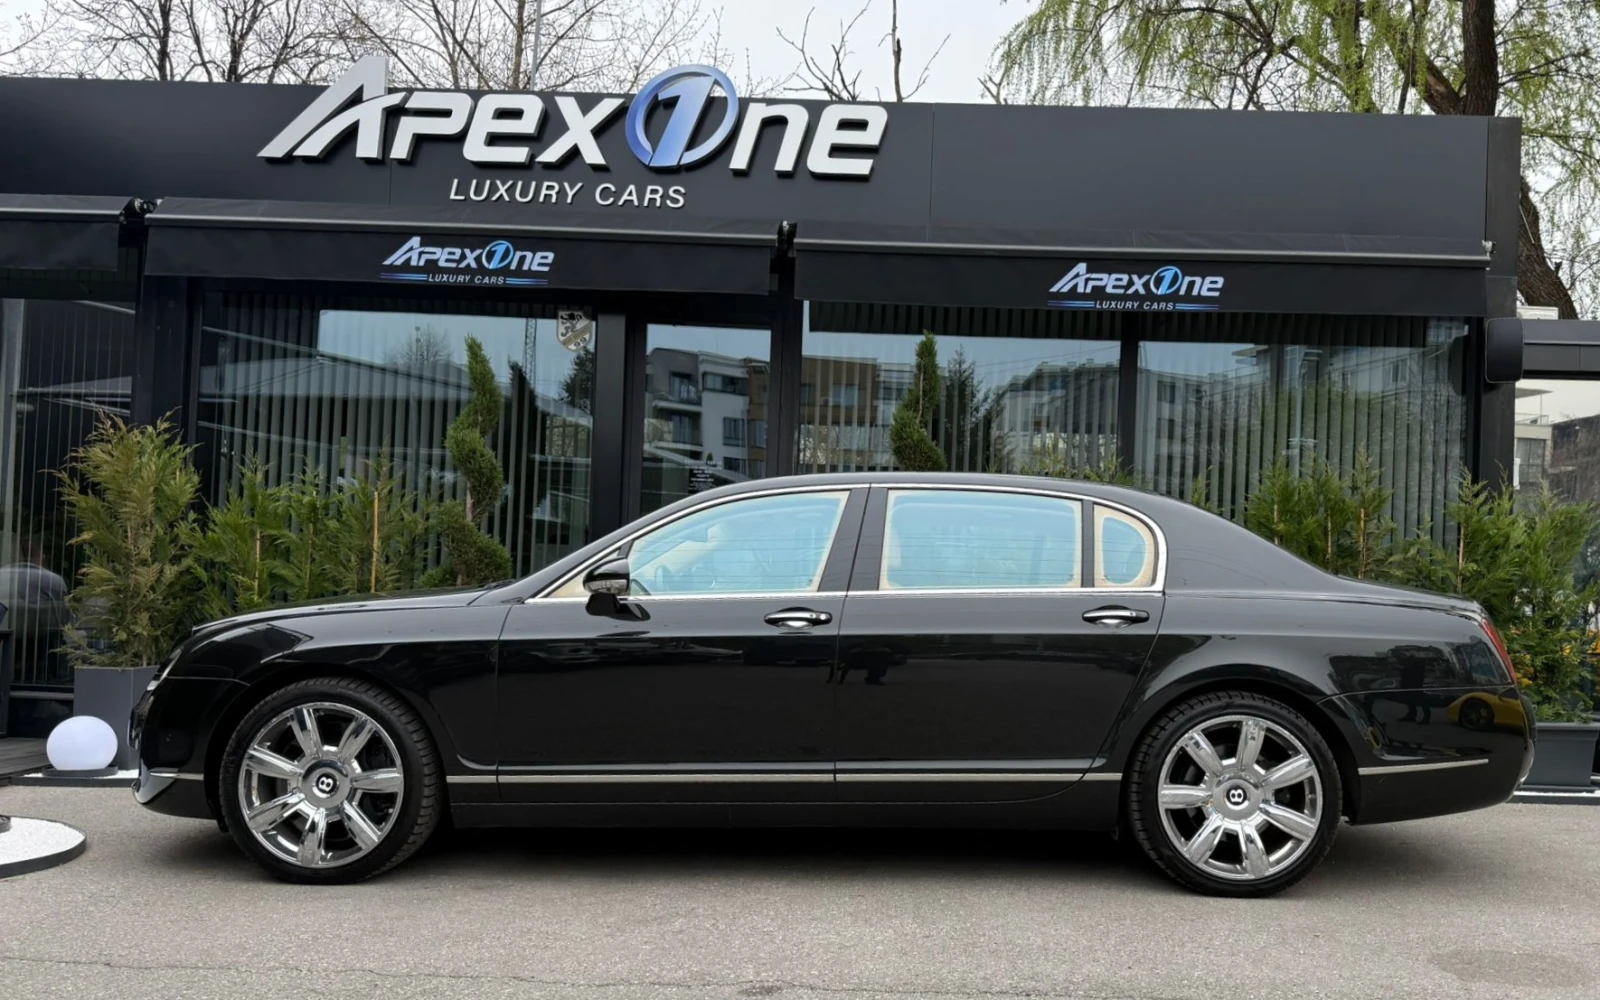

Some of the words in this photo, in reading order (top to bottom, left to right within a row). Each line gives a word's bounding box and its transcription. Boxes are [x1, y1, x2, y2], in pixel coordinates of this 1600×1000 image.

[449, 178, 583, 204] LUXURY
[595, 183, 686, 208] CARS
[428, 274, 470, 283] LUXURY
[474, 275, 505, 285] CARS
[1096, 300, 1140, 310] LUXURY
[1143, 302, 1174, 311] CARS
[318, 776, 334, 792] B
[1229, 788, 1244, 803] B
